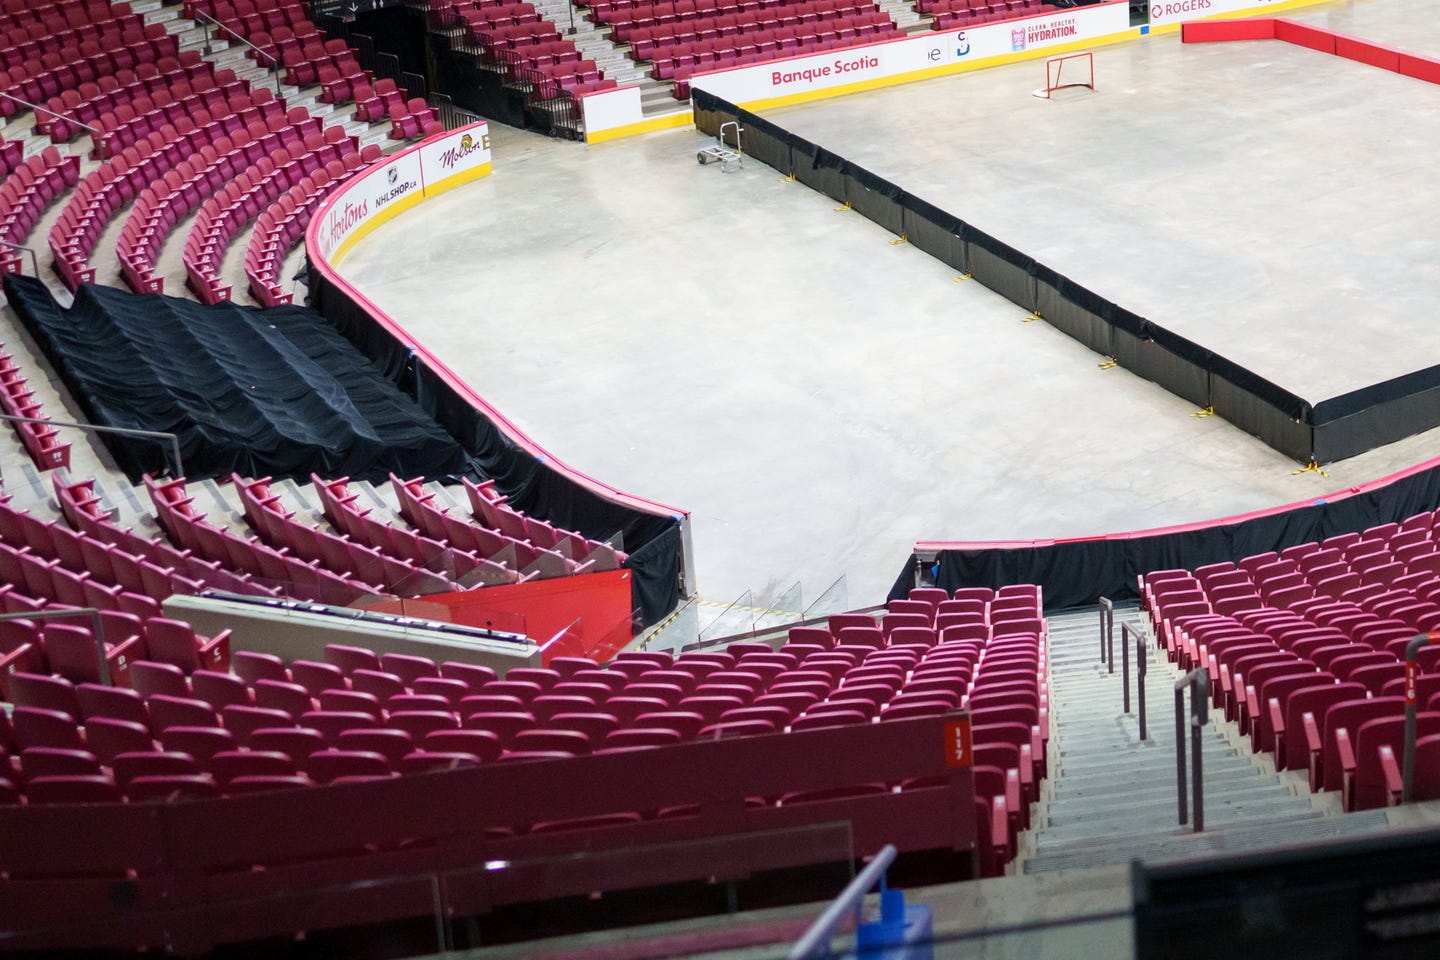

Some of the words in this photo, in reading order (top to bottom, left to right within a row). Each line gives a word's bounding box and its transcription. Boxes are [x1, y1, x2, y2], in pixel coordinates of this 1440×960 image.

[1028, 26, 1077, 44] HYDRATION.
[772, 65, 831, 86] Banque
[834, 55, 879, 74] Scotia
[440, 141, 480, 168] Molson
[331, 198, 368, 248] Hortons
[1407, 667, 1415, 699] 116
